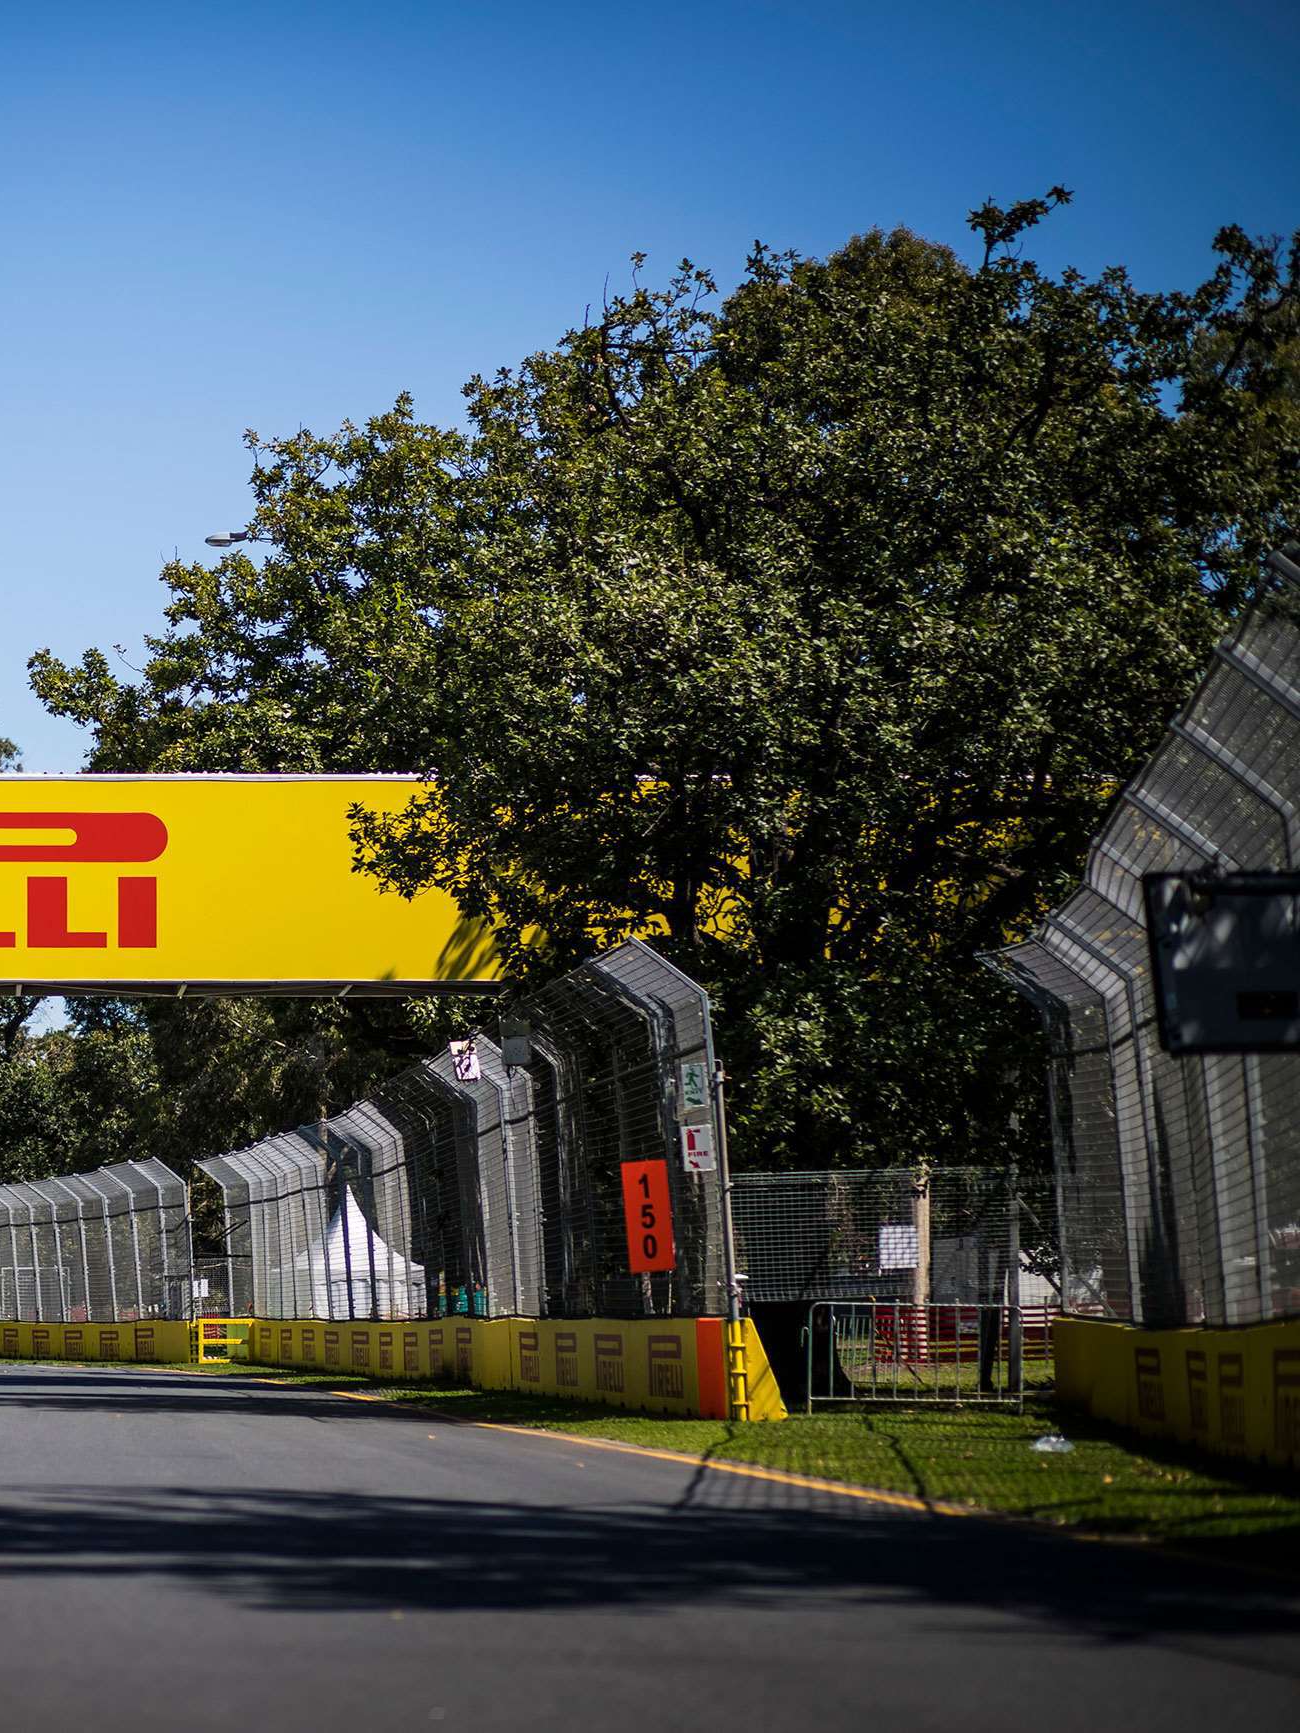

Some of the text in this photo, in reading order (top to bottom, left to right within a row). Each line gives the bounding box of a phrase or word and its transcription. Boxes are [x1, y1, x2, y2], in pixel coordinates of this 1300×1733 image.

[688, 1150, 709, 1158] FIRE
[638, 1173, 658, 1260] 150
[594, 1333, 626, 1393] PIRELLI
[647, 1335, 685, 1399] PIRELLI
